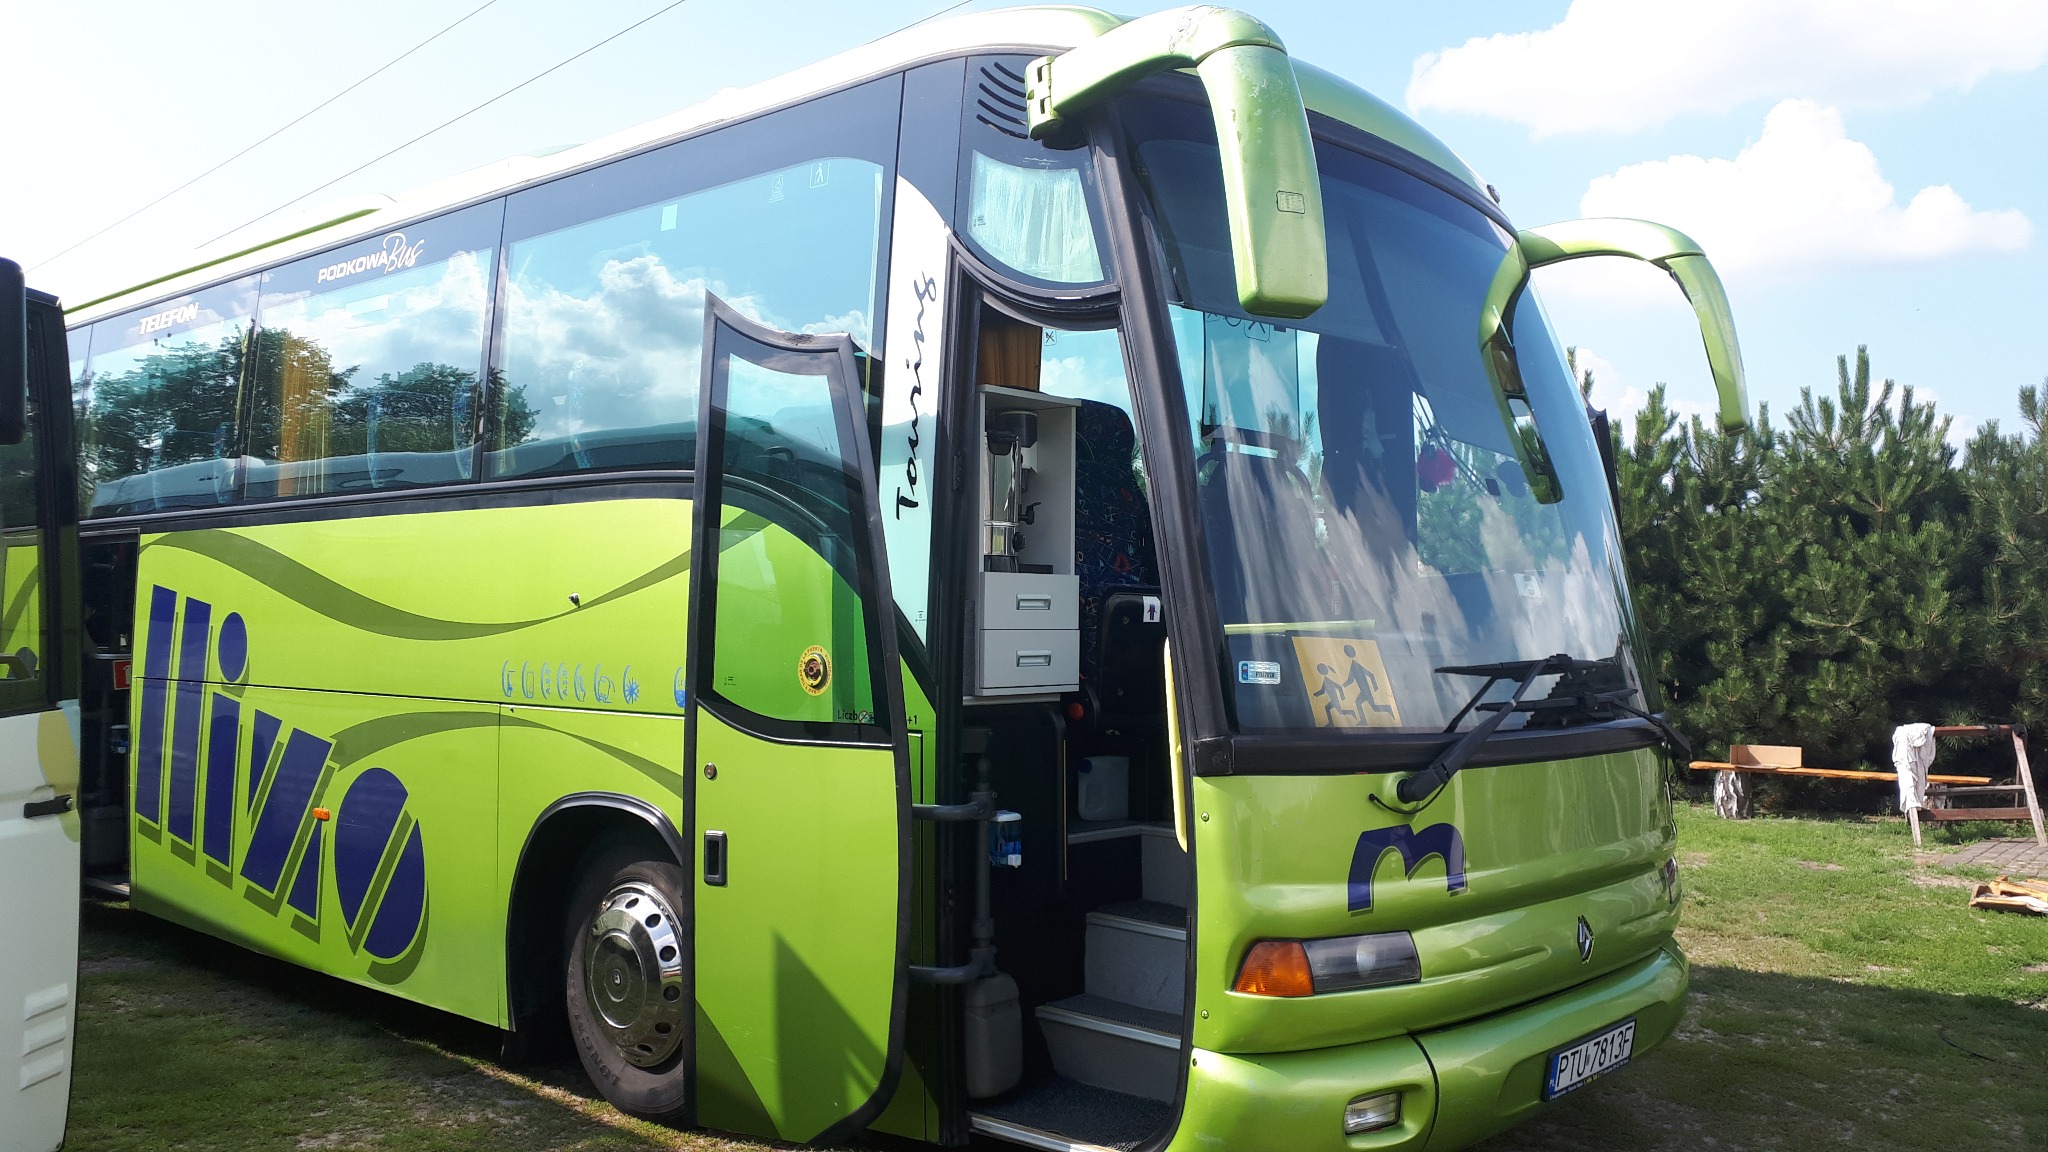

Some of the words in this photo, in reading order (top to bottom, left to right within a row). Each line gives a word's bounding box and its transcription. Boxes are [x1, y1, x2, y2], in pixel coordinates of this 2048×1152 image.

[139, 302, 199, 335] TELEFON
[896, 271, 937, 520] Touring
[837, 710, 859, 721] Liczb
